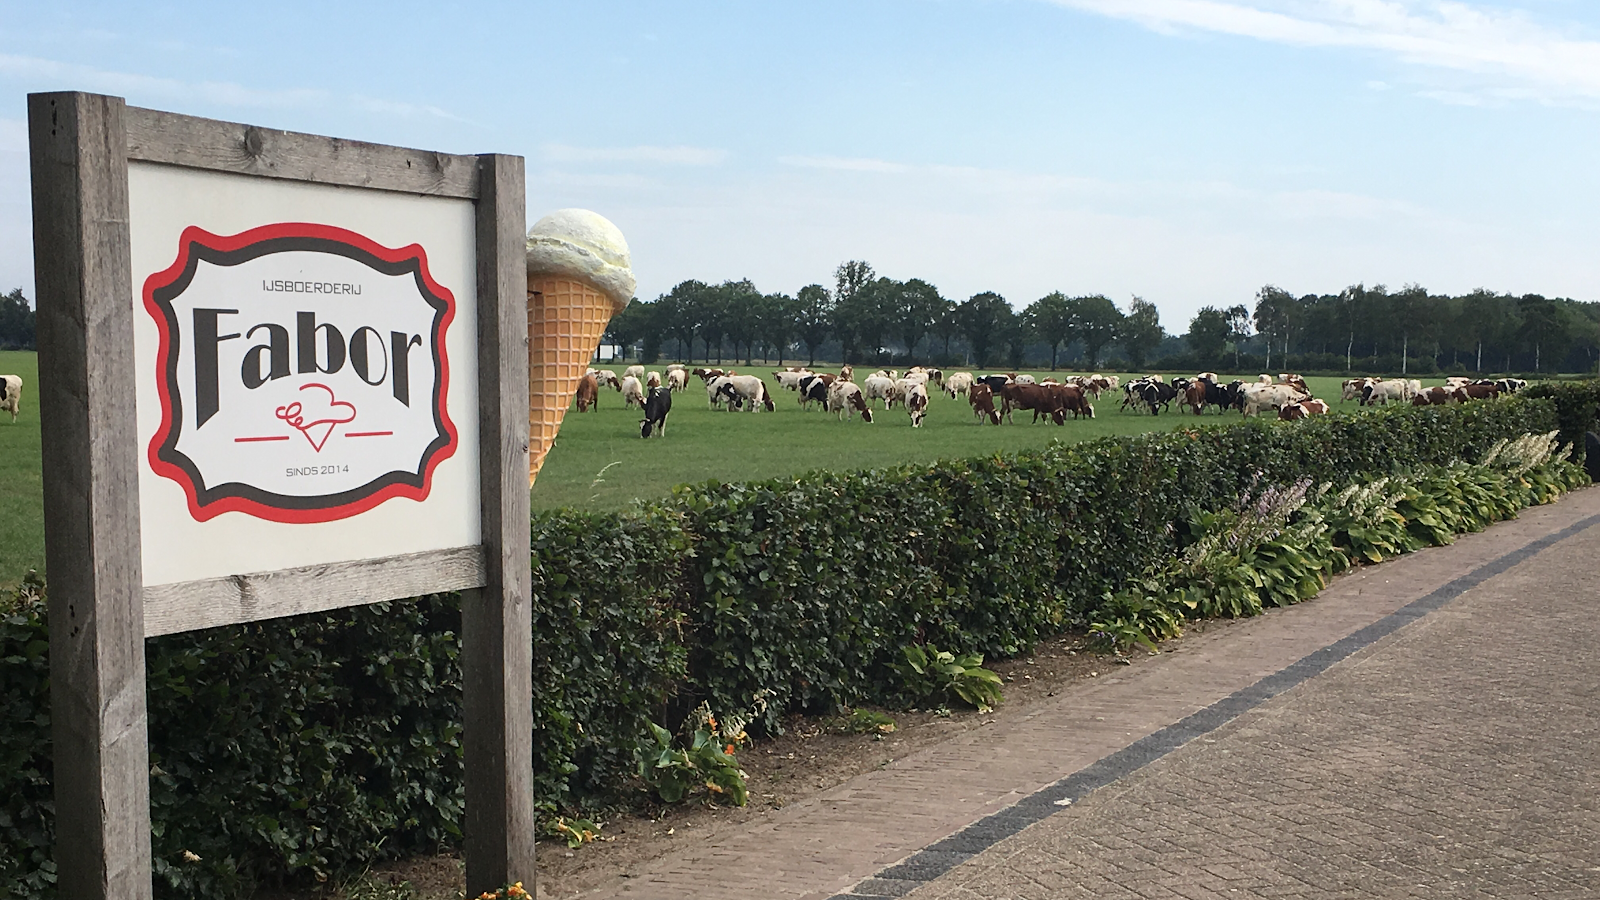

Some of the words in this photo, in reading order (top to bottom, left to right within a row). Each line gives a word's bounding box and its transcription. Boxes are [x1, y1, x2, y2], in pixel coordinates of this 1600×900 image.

[262, 279, 362, 296] IJSBOERDERIJ
[192, 307, 422, 431] Fabor
[285, 466, 319, 477] SINDS
[320, 464, 350, 475] 2014
